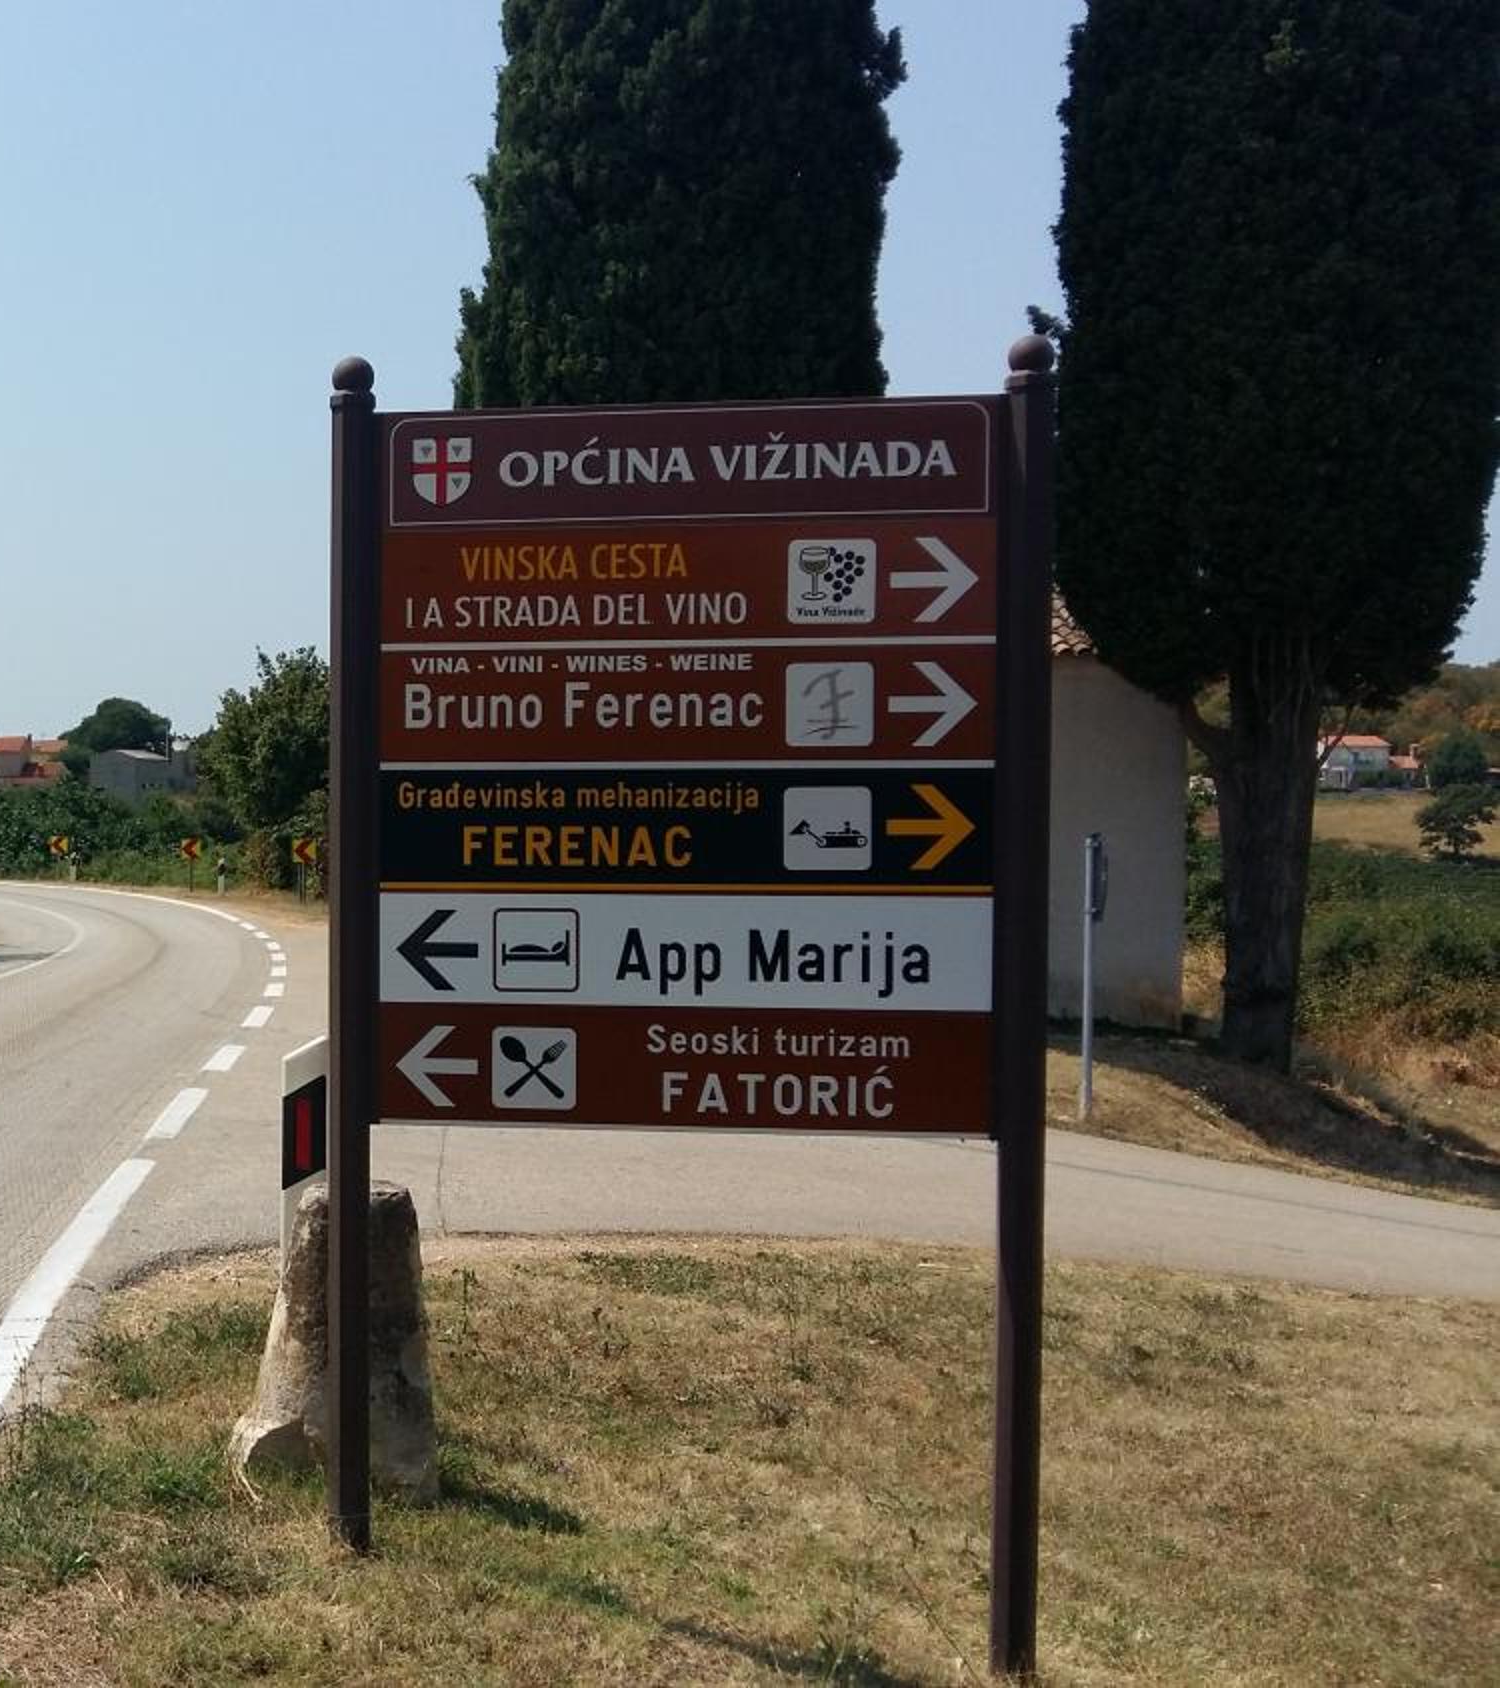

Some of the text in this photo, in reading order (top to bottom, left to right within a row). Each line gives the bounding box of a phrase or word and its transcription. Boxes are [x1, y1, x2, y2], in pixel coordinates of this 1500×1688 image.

[499, 431, 957, 487] OPĆINA VIŽINADA
[461, 543, 687, 581] VINSKA CESTA
[454, 594, 581, 628] STRADA
[593, 593, 651, 626] DEL
[665, 591, 747, 625] VINO
[410, 657, 471, 675] VINA
[491, 655, 543, 673] VINI
[565, 654, 648, 673] WINES
[669, 653, 753, 672] WEINE
[405, 681, 764, 729] Bruno Ferenac
[576, 781, 759, 815] mehanizacija
[463, 825, 691, 867] FERENAC
[615, 927, 930, 999] App Marija
[646, 1024, 910, 1058] Seoski turizam
[662, 1065, 894, 1118] FATORIĆ
